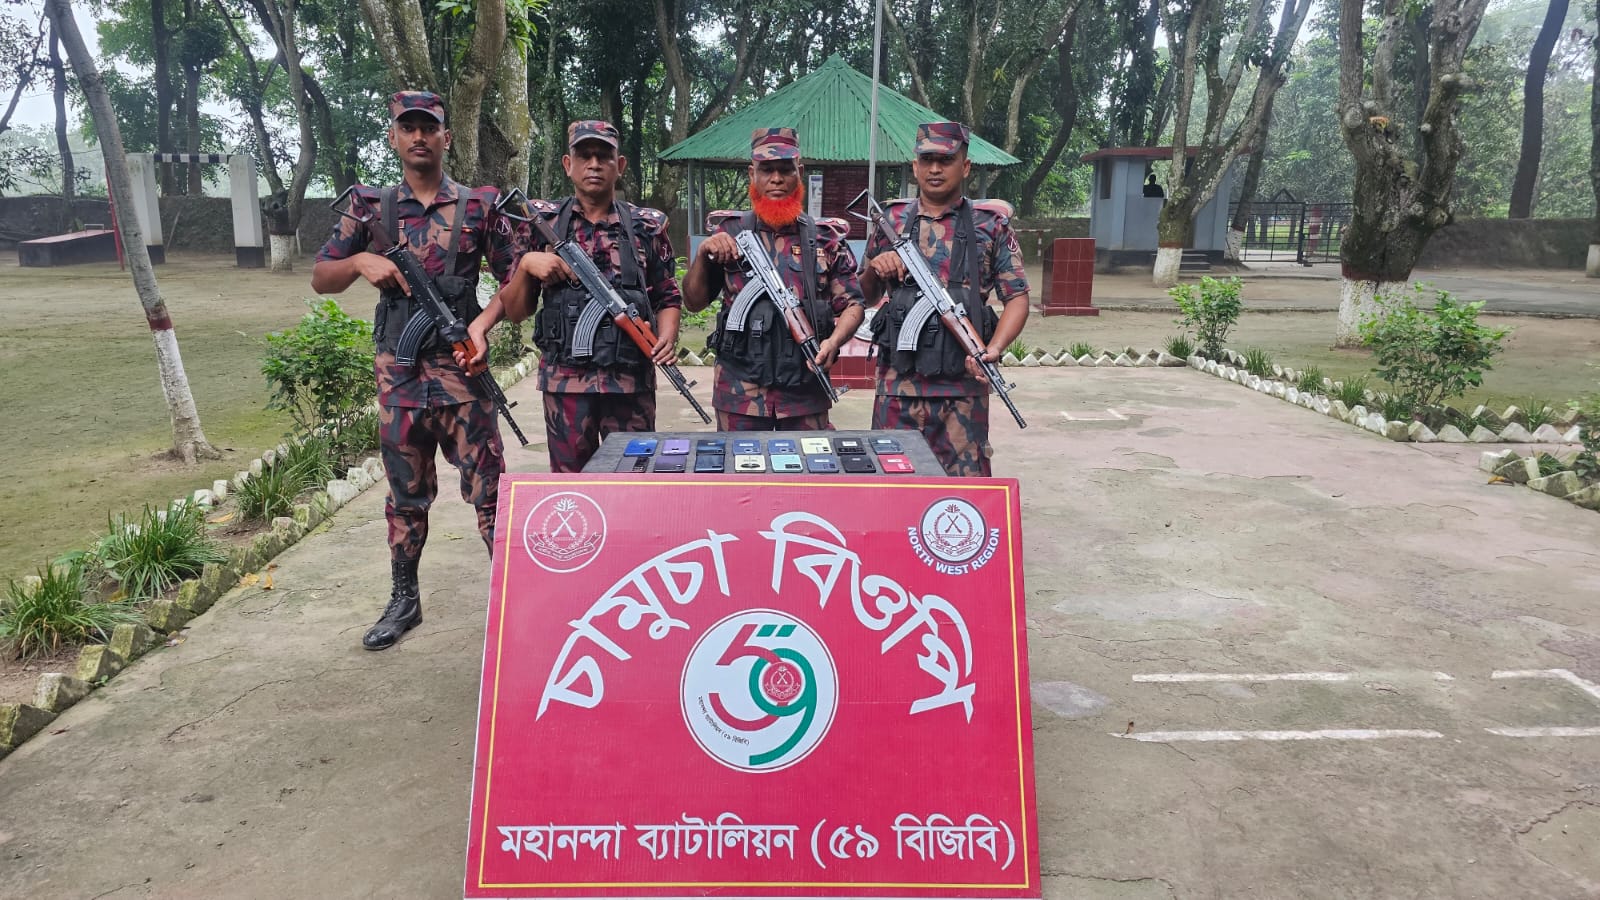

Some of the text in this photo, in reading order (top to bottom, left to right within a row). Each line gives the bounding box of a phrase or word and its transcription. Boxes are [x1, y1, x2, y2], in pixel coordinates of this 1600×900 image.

[907, 526, 1000, 575] NORTH WEST REGION
[536, 511, 976, 724] চামুচা বিওপি
[497, 812, 1016, 870] মহানন্দা ব্যাটালিয়ন (৫৯ বিজিবি)
